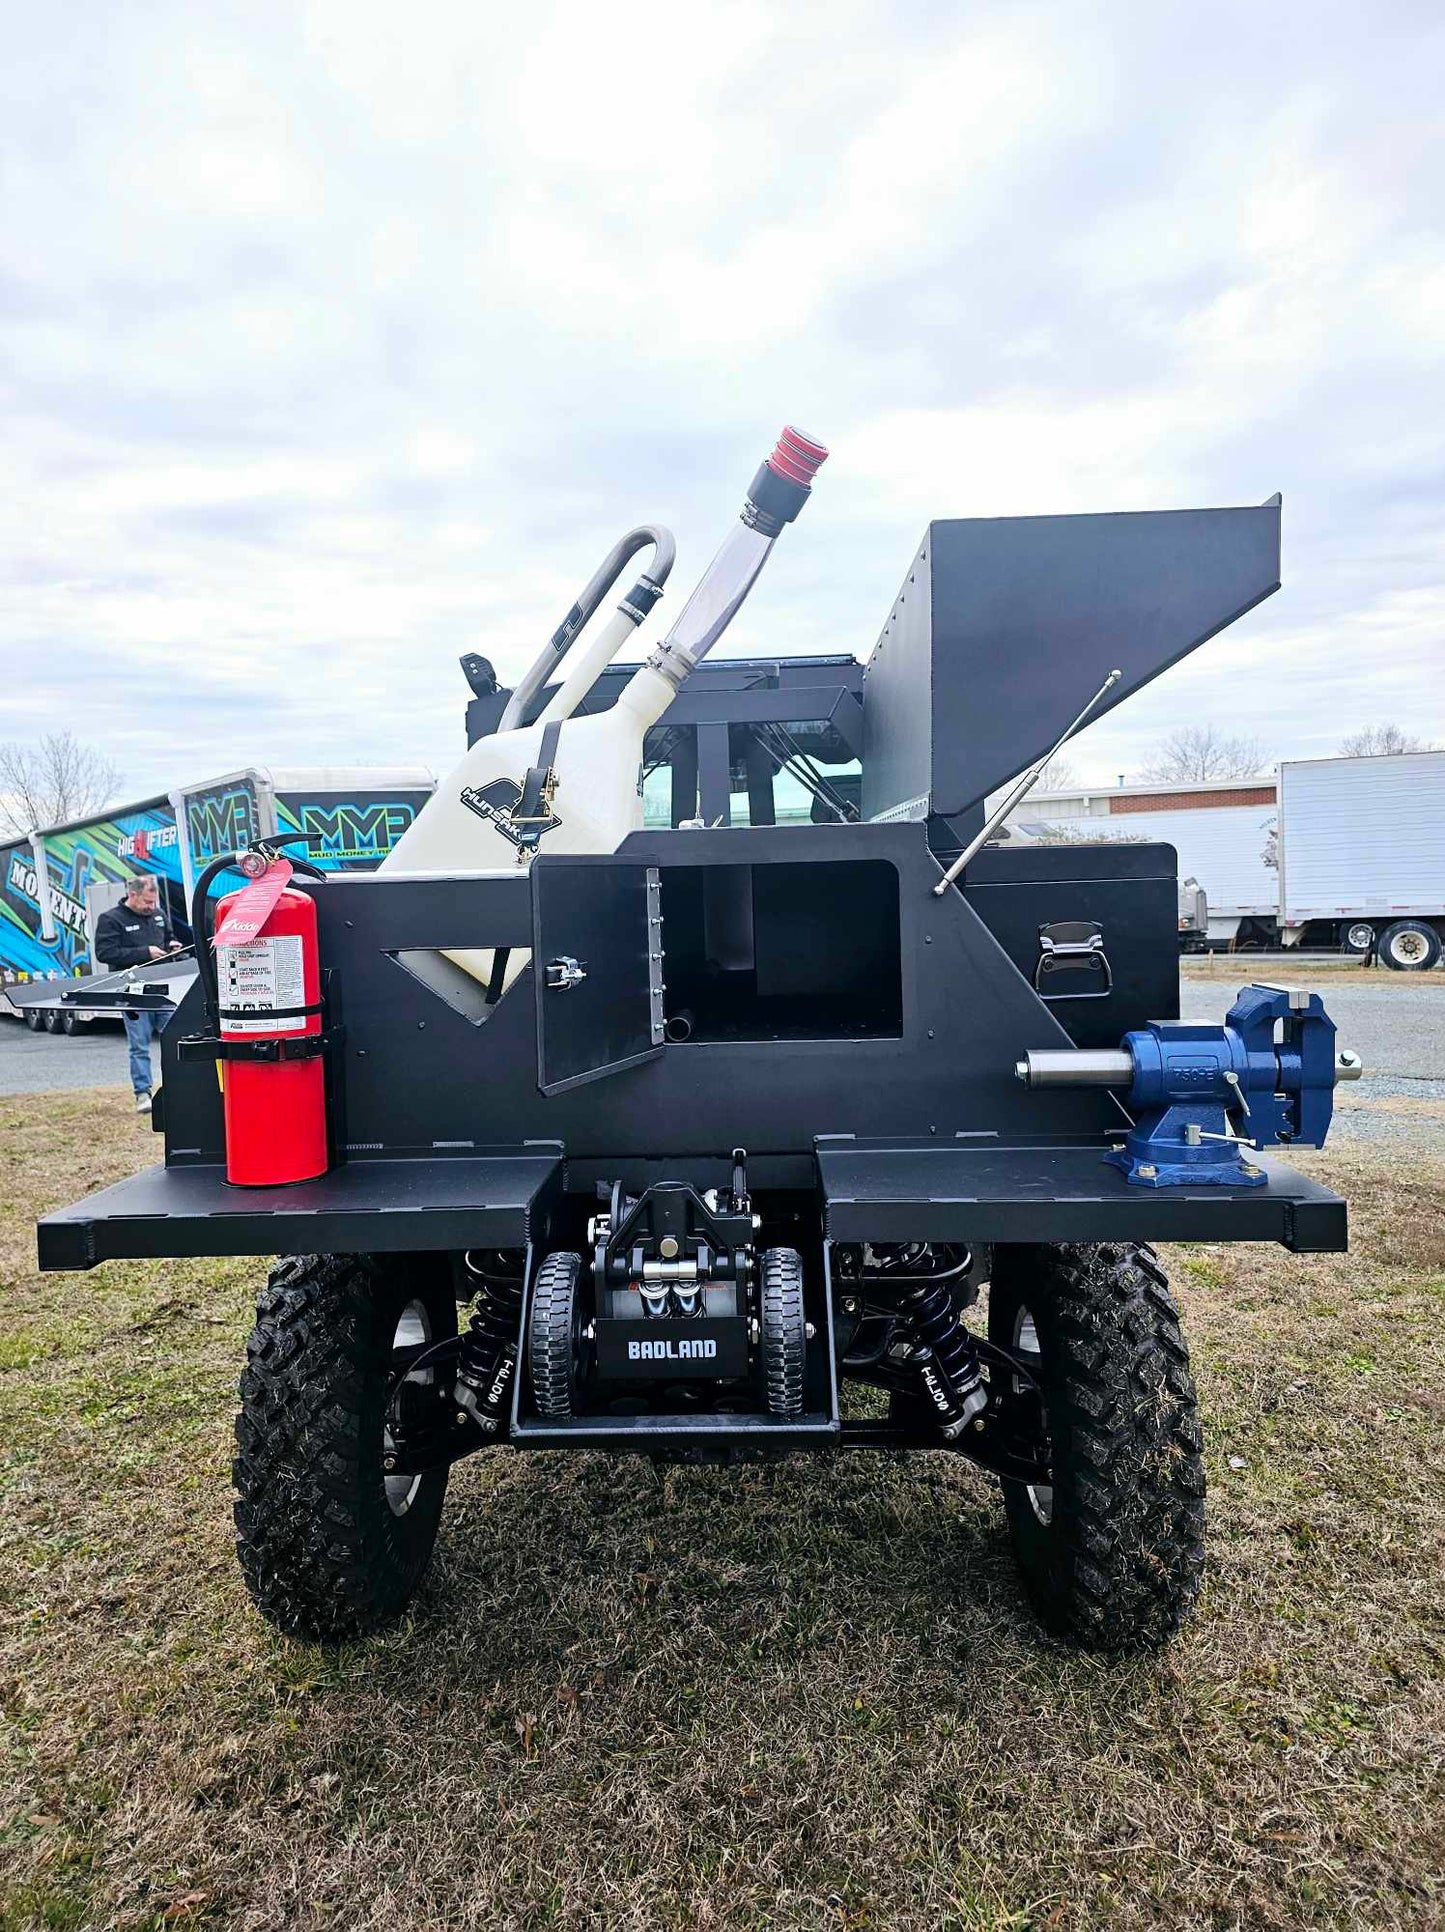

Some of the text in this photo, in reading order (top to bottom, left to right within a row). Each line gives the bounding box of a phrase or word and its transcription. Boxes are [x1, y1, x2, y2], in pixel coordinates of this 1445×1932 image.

[461, 787, 521, 838] HUNSAK
[336, 849, 376, 858] MONEY
[10, 860, 88, 936] MOENT
[628, 1340, 717, 1360] BADLAND
